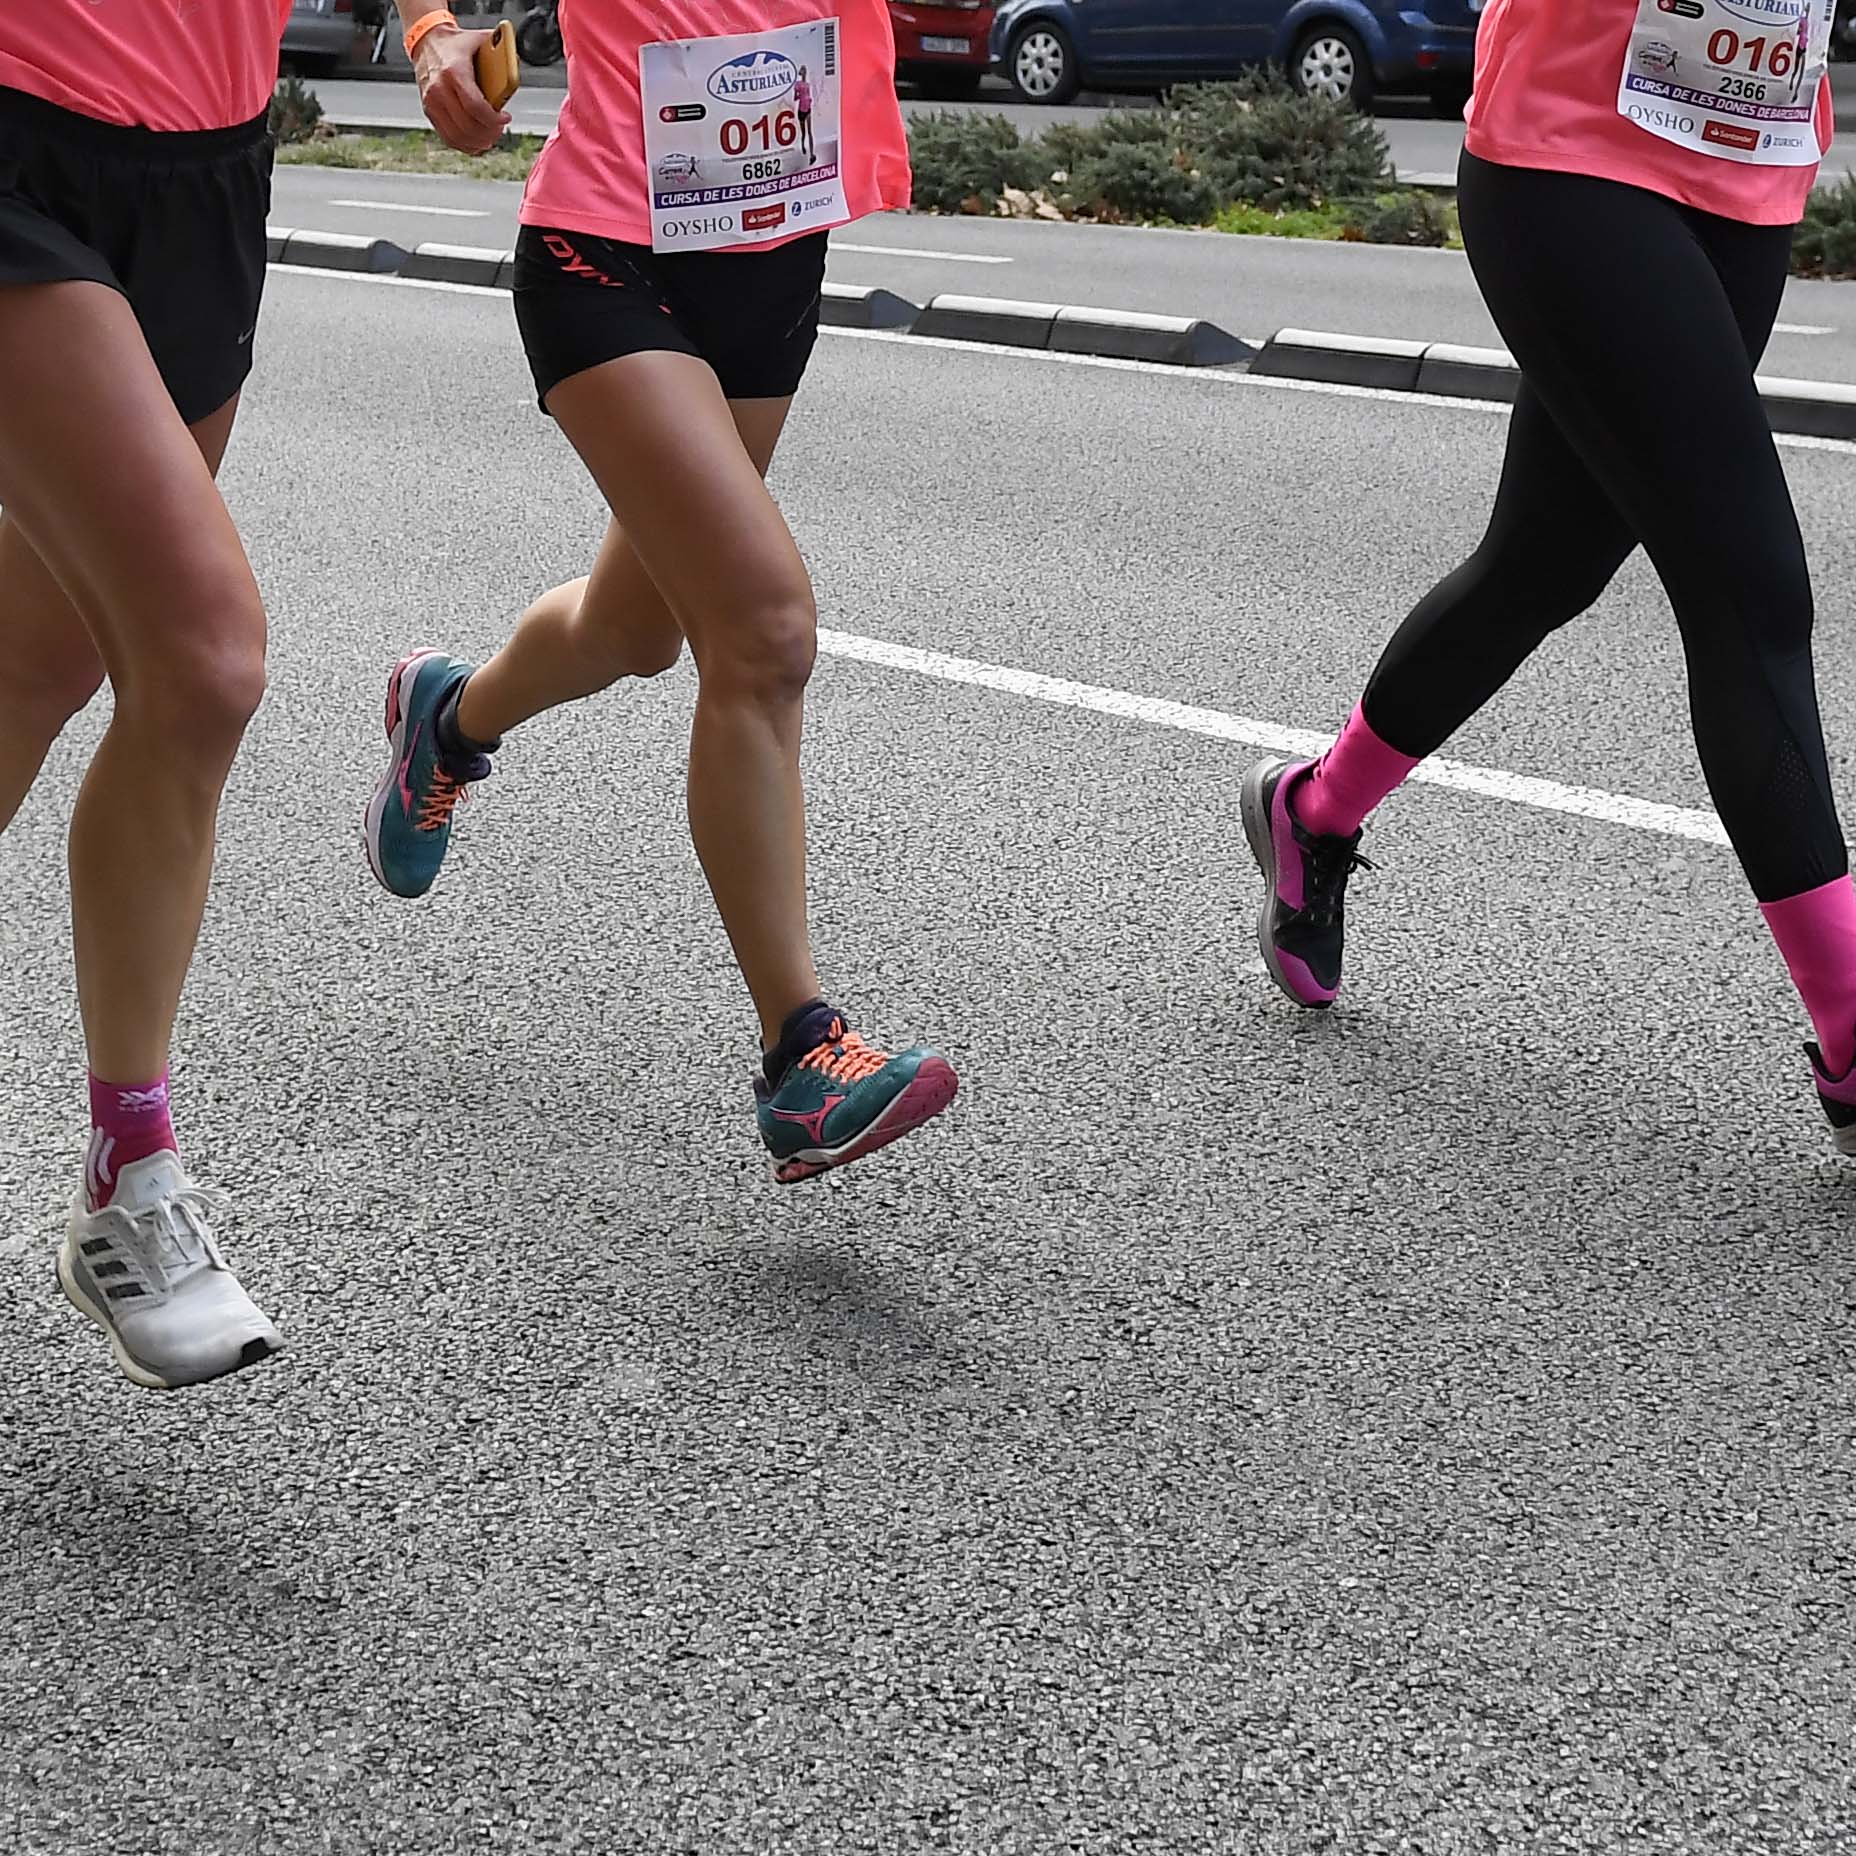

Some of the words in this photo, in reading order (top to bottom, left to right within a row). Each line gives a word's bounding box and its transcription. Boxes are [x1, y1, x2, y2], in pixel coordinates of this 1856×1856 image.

[1707, 28, 1795, 77] 016
[716, 70, 793, 95] ASTURIANA
[1718, 76, 1767, 101] 2366
[1632, 77, 1670, 96] CURSA
[1671, 87, 1689, 101] DE
[1691, 92, 1715, 107] LES
[1716, 98, 1757, 116] DONES
[1756, 107, 1769, 119] DE
[1627, 103, 1694, 134] OYSHO
[719, 110, 797, 156] 016
[743, 158, 782, 181] 6862
[661, 192, 701, 206] CURSA
[703, 189, 721, 203] DE
[721, 186, 744, 200] LES
[745, 181, 778, 197] DONES
[778, 177, 792, 190] DE
[791, 164, 836, 188] BARCELONA
[804, 196, 833, 212] ZURICH
[662, 215, 734, 238] OYSHO
